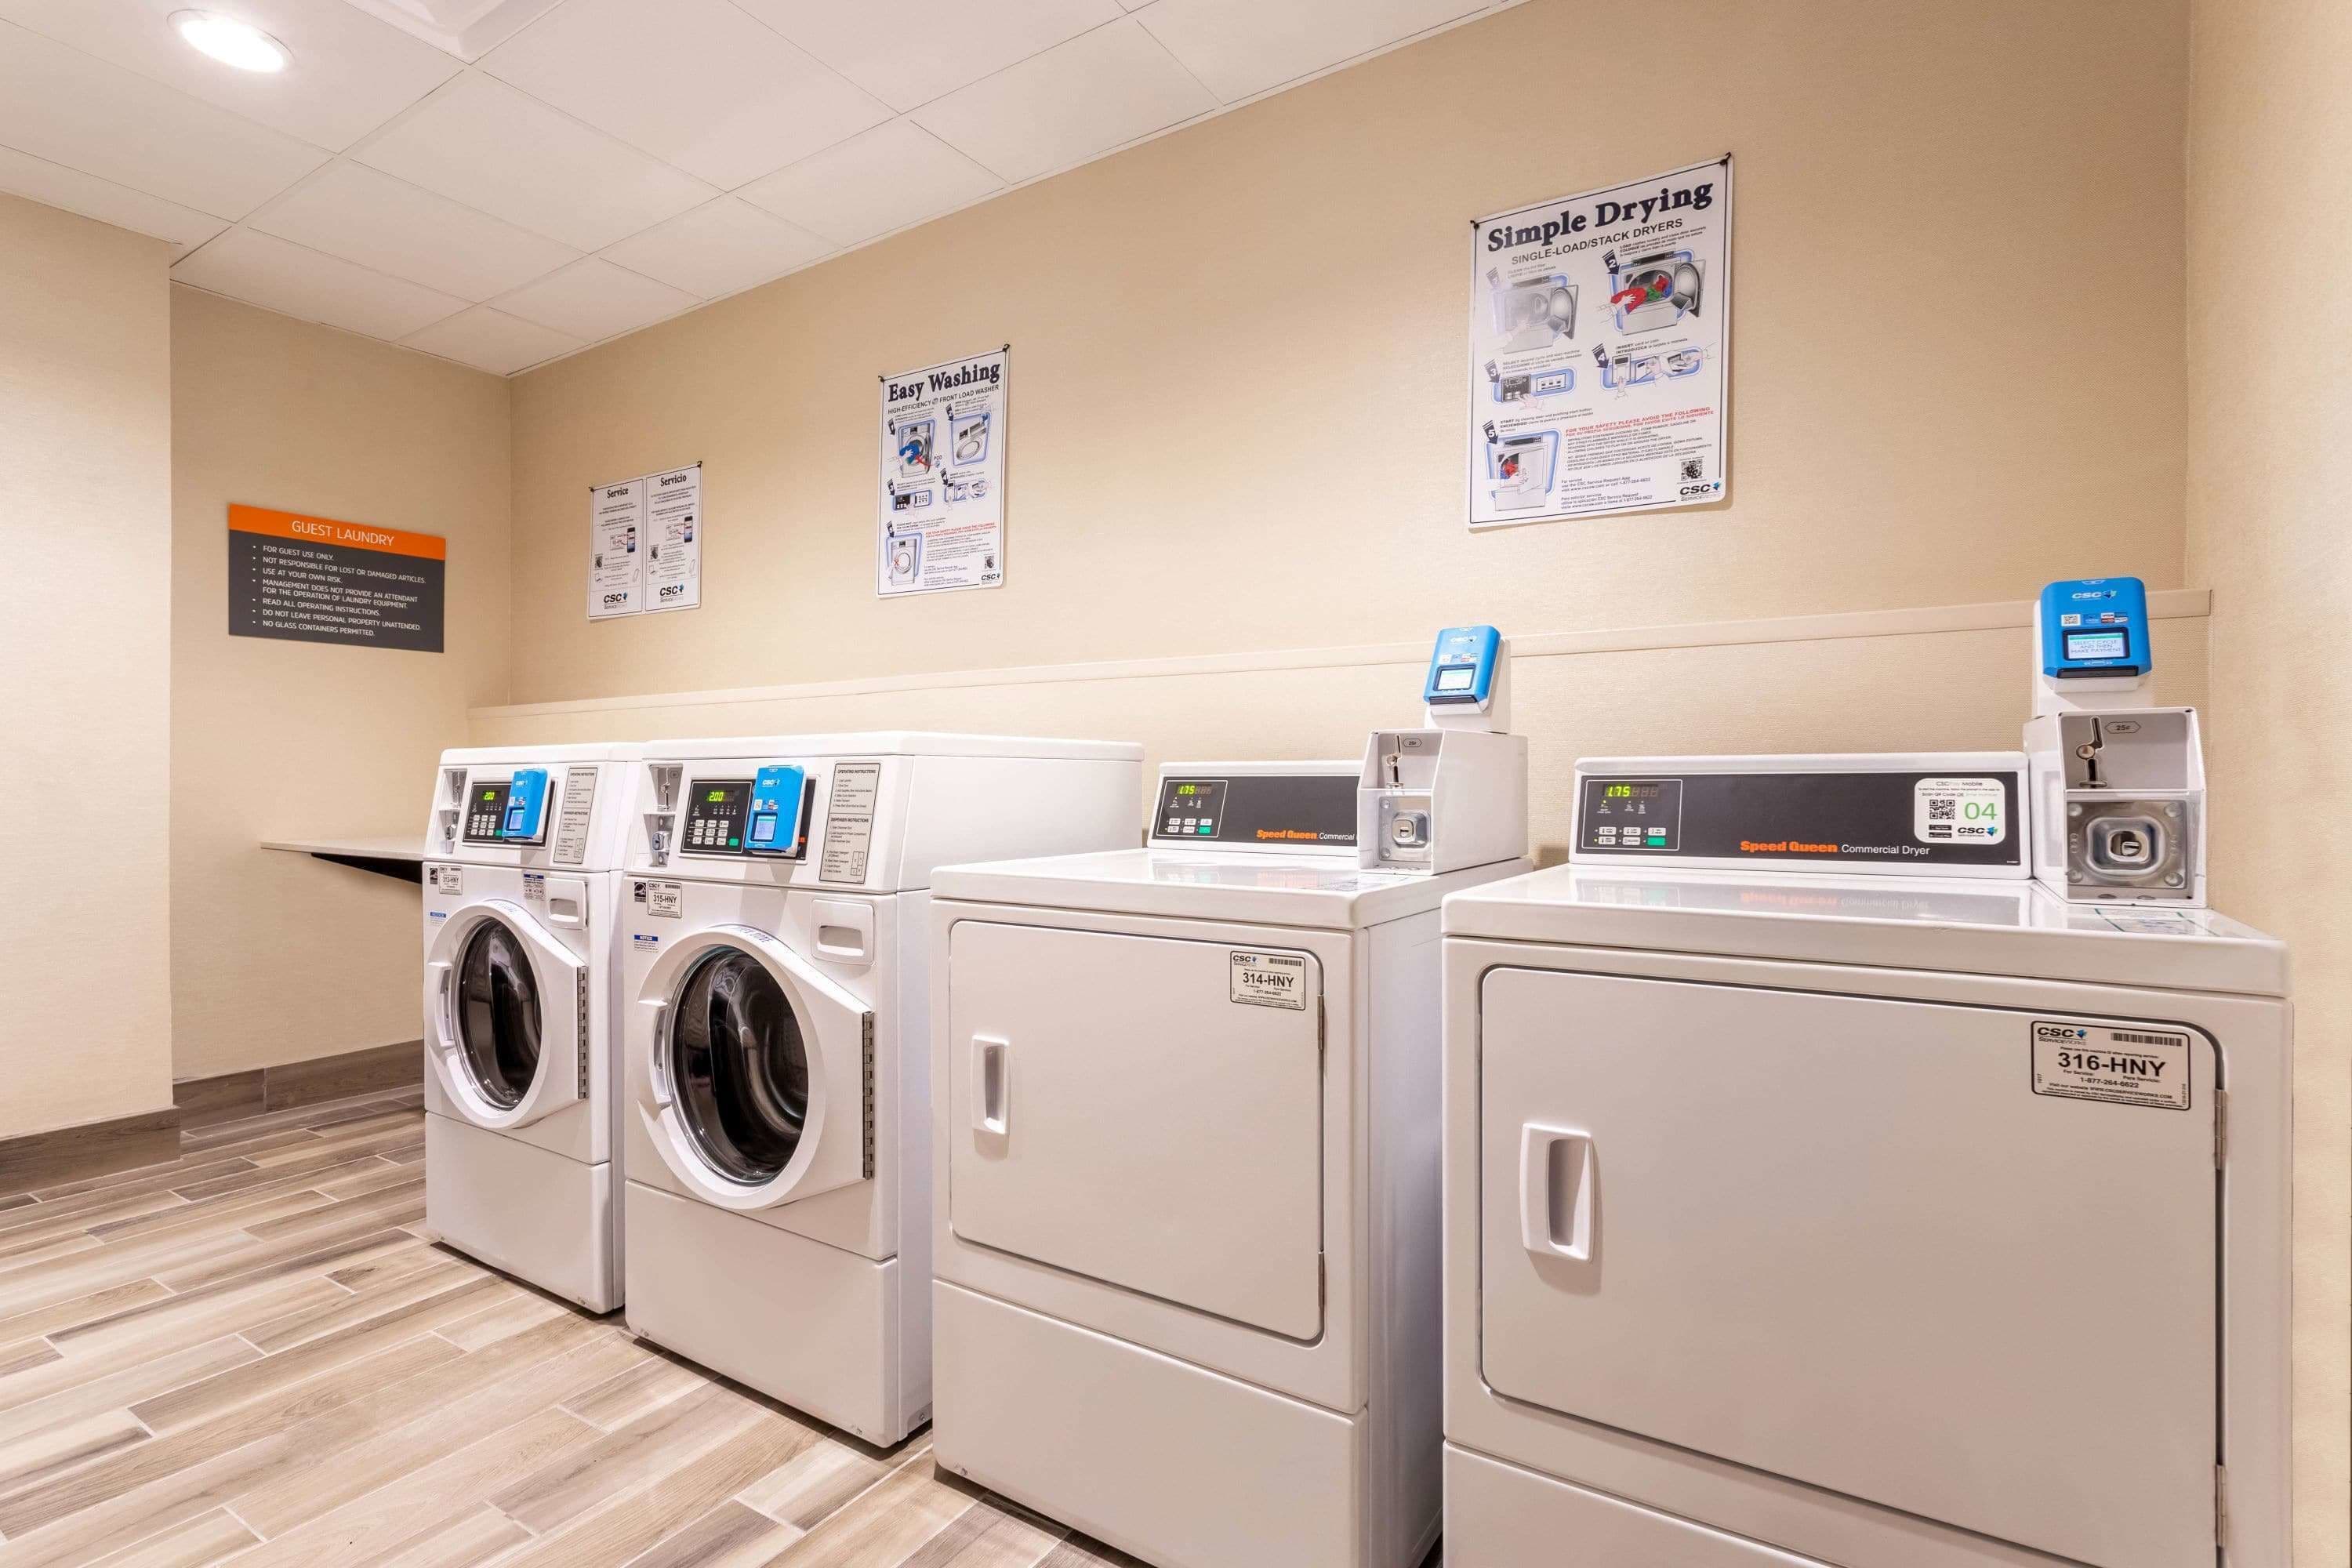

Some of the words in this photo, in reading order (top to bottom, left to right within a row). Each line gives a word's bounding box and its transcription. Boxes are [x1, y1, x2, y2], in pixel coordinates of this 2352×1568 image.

[1488, 210, 1586, 252] Simple
[1595, 183, 1714, 223] Drying
[1512, 230, 1630, 265] SINGLE-LOAD/STACK
[1633, 218, 1683, 238] DRYERS
[1609, 260, 1617, 268] 2
[888, 382, 924, 401] Easy
[928, 364, 1000, 392] Washing
[939, 394, 958, 403] FRONT
[959, 390, 974, 399] LOAD
[975, 384, 1000, 394] WASHER
[660, 473, 687, 487] Servicio
[607, 487, 629, 499] Service
[1679, 484, 1711, 495] CSC
[292, 521, 332, 537] GUEST
[337, 528, 394, 546] LAUNDRY
[278, 547, 300, 556] GUEST
[278, 558, 323, 570] RESPONSIBLE
[367, 570, 397, 579] DAMAGED
[263, 579, 310, 590] MANAGEMENT
[311, 584, 328, 593] DOES
[345, 588, 372, 597] PROVIDE
[384, 593, 418, 603] ATTENDANT
[293, 590, 330, 601] OPERATION
[342, 596, 372, 604] LAUNDRY
[659, 585, 678, 597] CSC
[603, 593, 622, 604] CSC
[297, 601, 334, 612] OPERATING
[291, 612, 312, 620] LEAVE
[313, 614, 346, 623] PERSONAL
[348, 617, 381, 626] PROPERTY
[298, 623, 339, 633] CONTAINERS
[1965, 802, 1998, 820] 04
[1256, 829, 1287, 840] Speed
[1287, 829, 1318, 840] Queen
[1319, 832, 1355, 840] Commercial
[1740, 840, 1787, 853] Speed
[1789, 840, 1838, 853] Queen
[1842, 844, 1900, 854] Commercial
[1901, 844, 1929, 856] Dryer
[653, 894, 677, 904] 315-HNY
[1243, 971, 1294, 988] 314-HNY
[2037, 1026, 2074, 1038] CSC
[2057, 1052, 2166, 1077] 316-HNY
[2080, 1077, 2140, 1088] 1-877-264-6622
